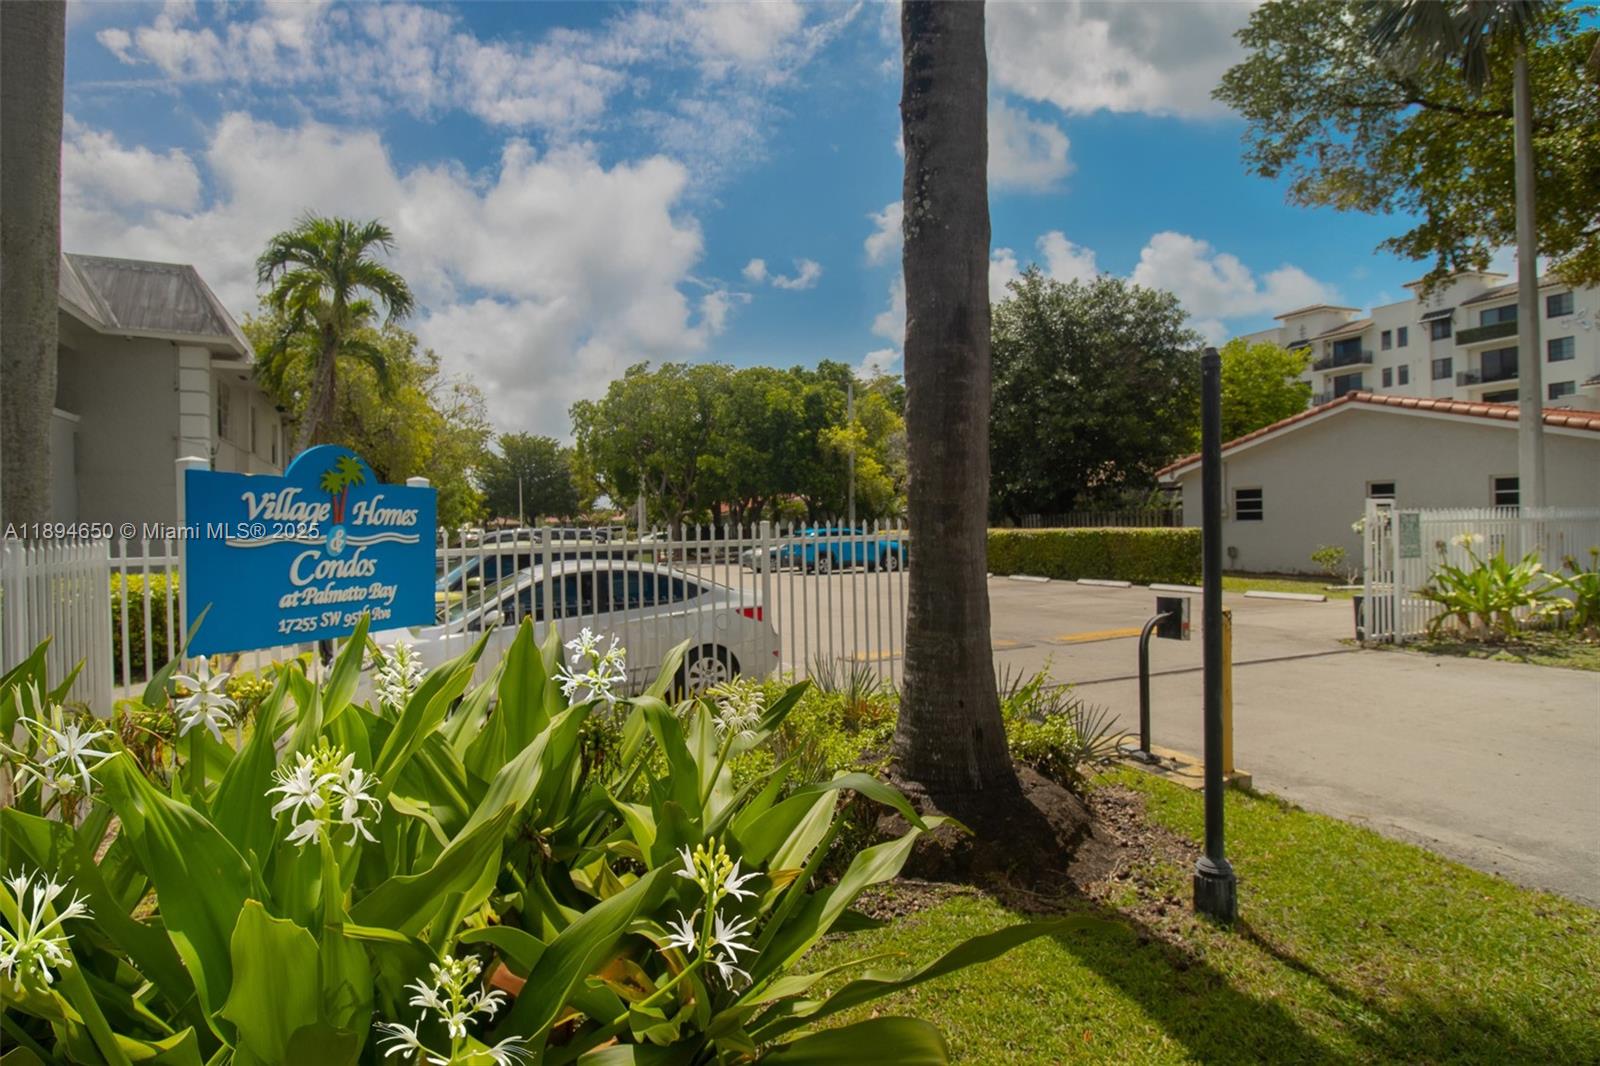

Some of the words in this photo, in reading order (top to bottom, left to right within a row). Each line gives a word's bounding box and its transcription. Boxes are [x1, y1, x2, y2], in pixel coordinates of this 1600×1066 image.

[241, 486, 331, 523] Village
[352, 494, 419, 527] Homes
[330, 528, 345, 553] &
[289, 545, 378, 586] Condos
[279, 590, 300, 608] at
[300, 581, 368, 606] Palmetto
[368, 582, 398, 606] Bay
[278, 616, 318, 634] 17255
[320, 611, 342, 627] SW
